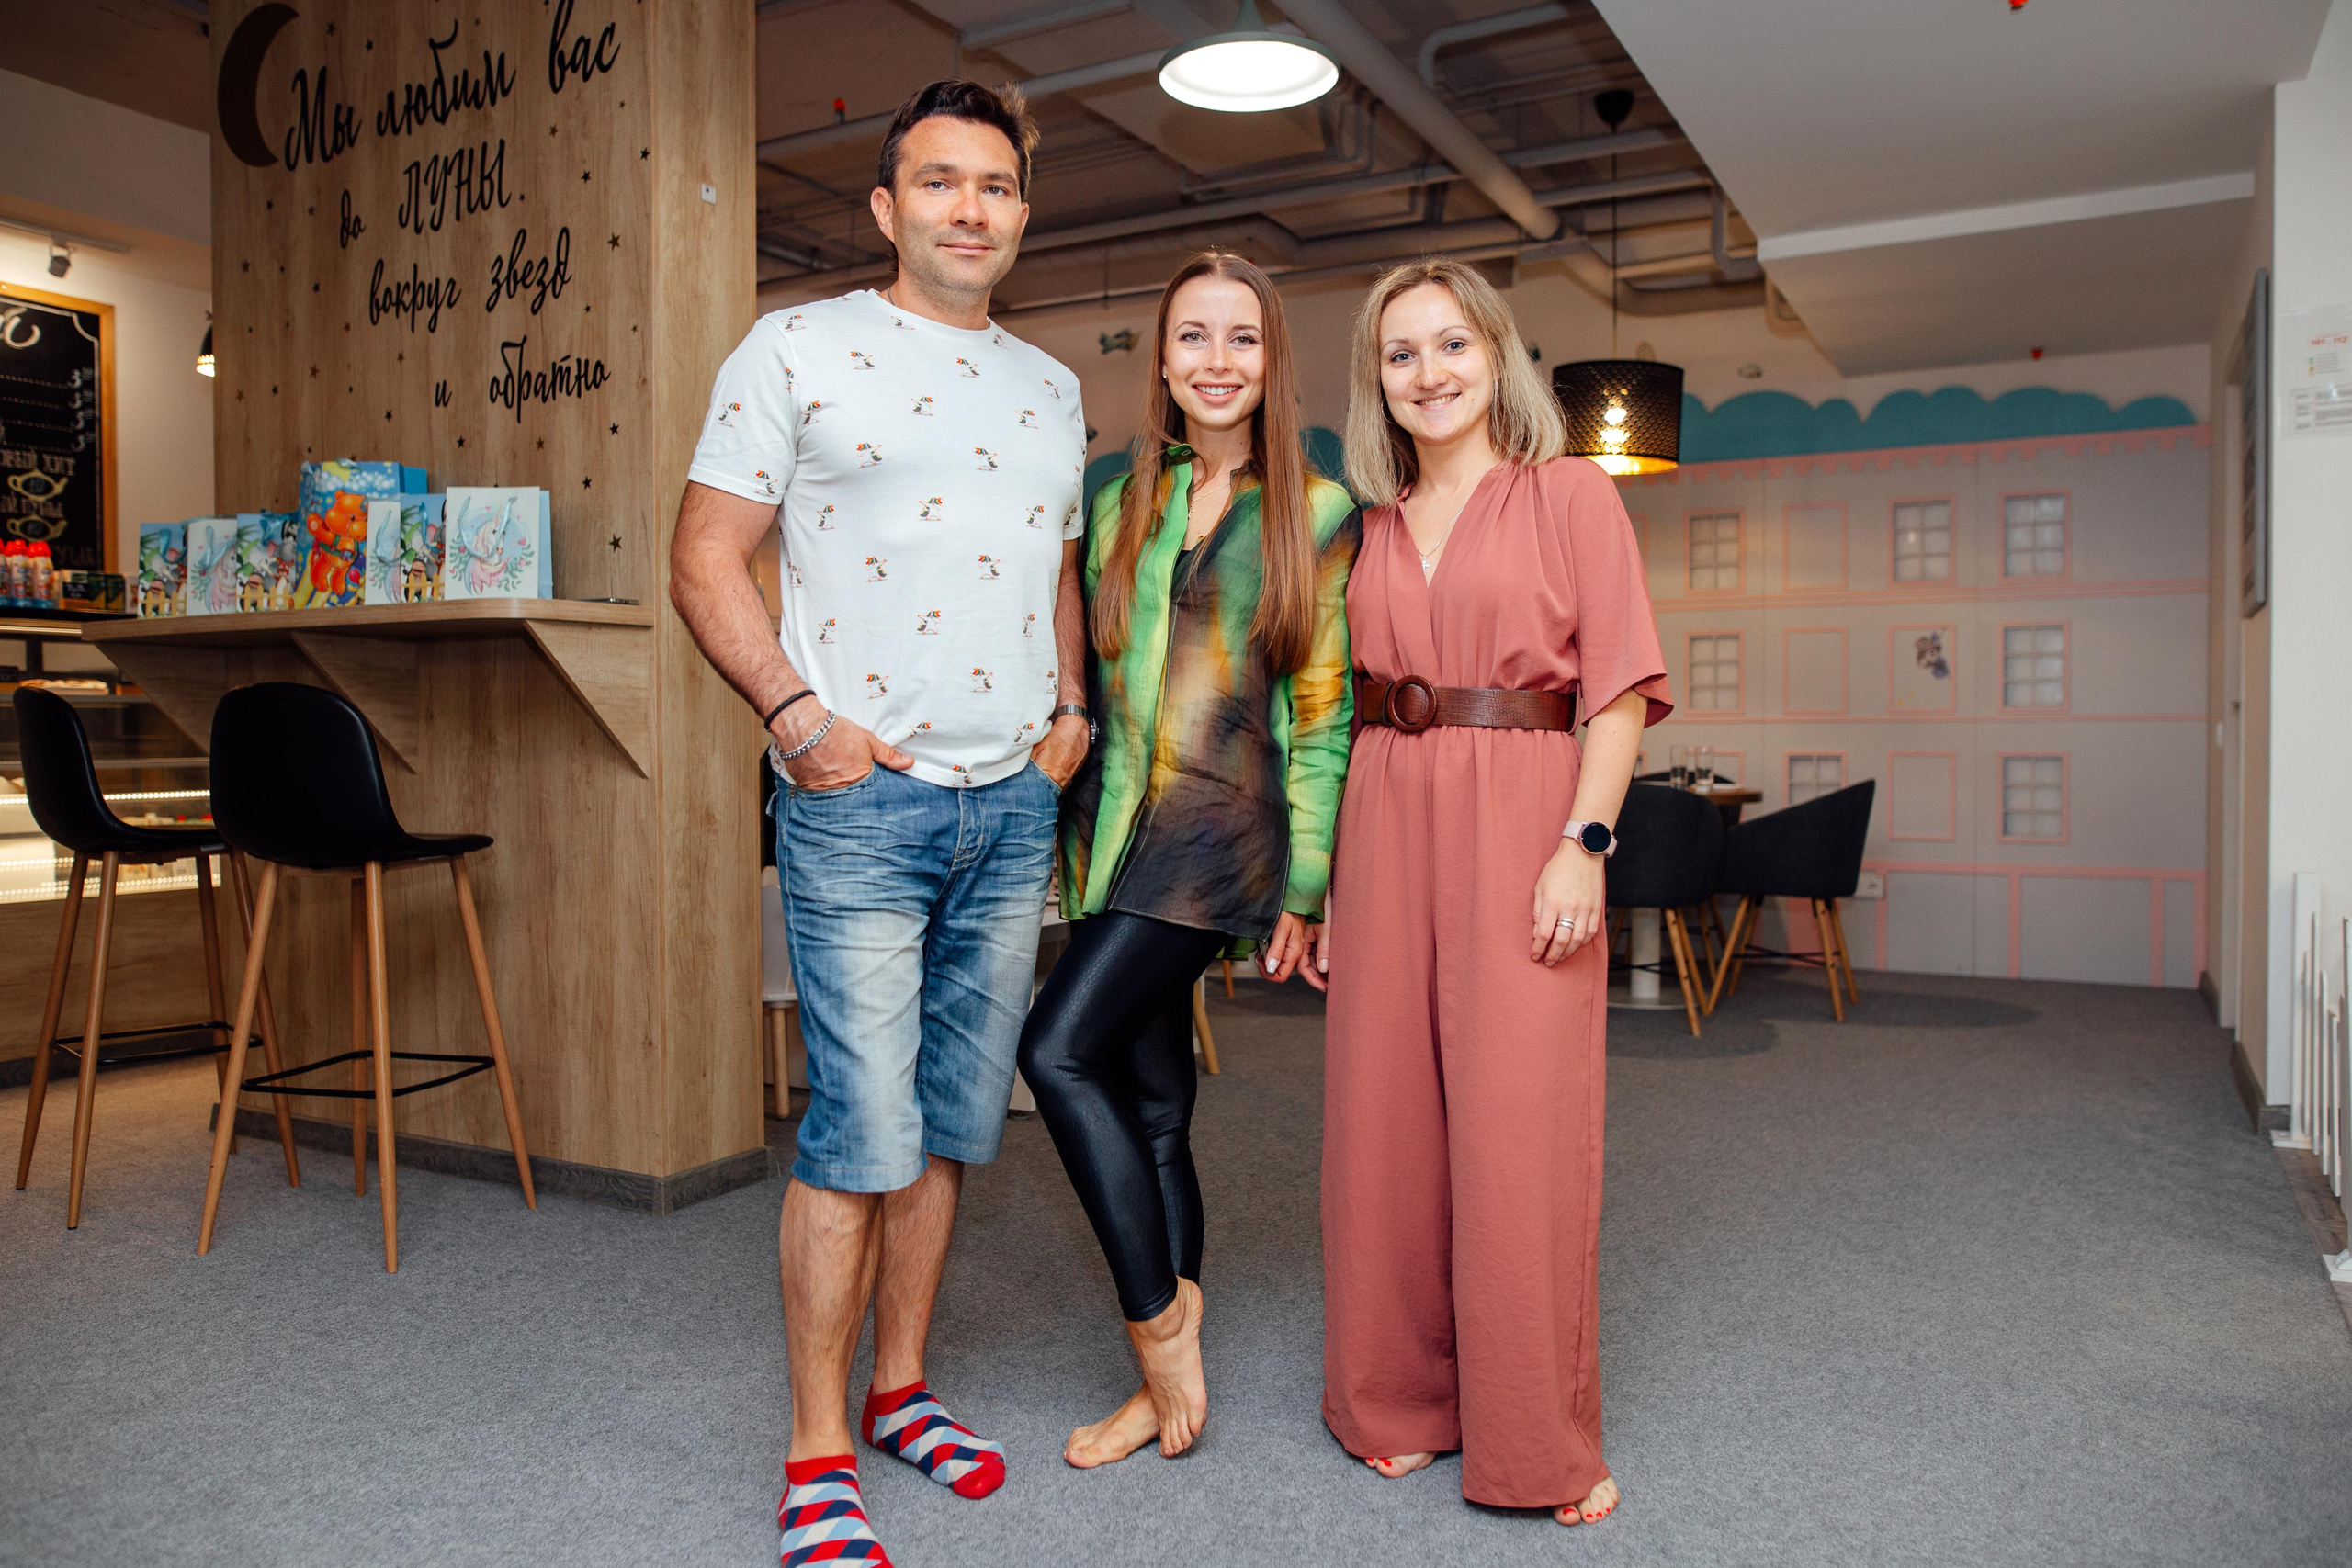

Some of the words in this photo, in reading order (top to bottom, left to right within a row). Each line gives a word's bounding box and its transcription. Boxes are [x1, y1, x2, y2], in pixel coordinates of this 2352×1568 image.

[284, 65, 361, 172] Мы
[376, 18, 517, 137] любим
[548, 0, 621, 94] вас
[339, 189, 366, 250] до
[368, 258, 462, 333] вокруг
[485, 226, 572, 315] звезд
[435, 379, 453, 408] и
[489, 334, 611, 424] обратно
